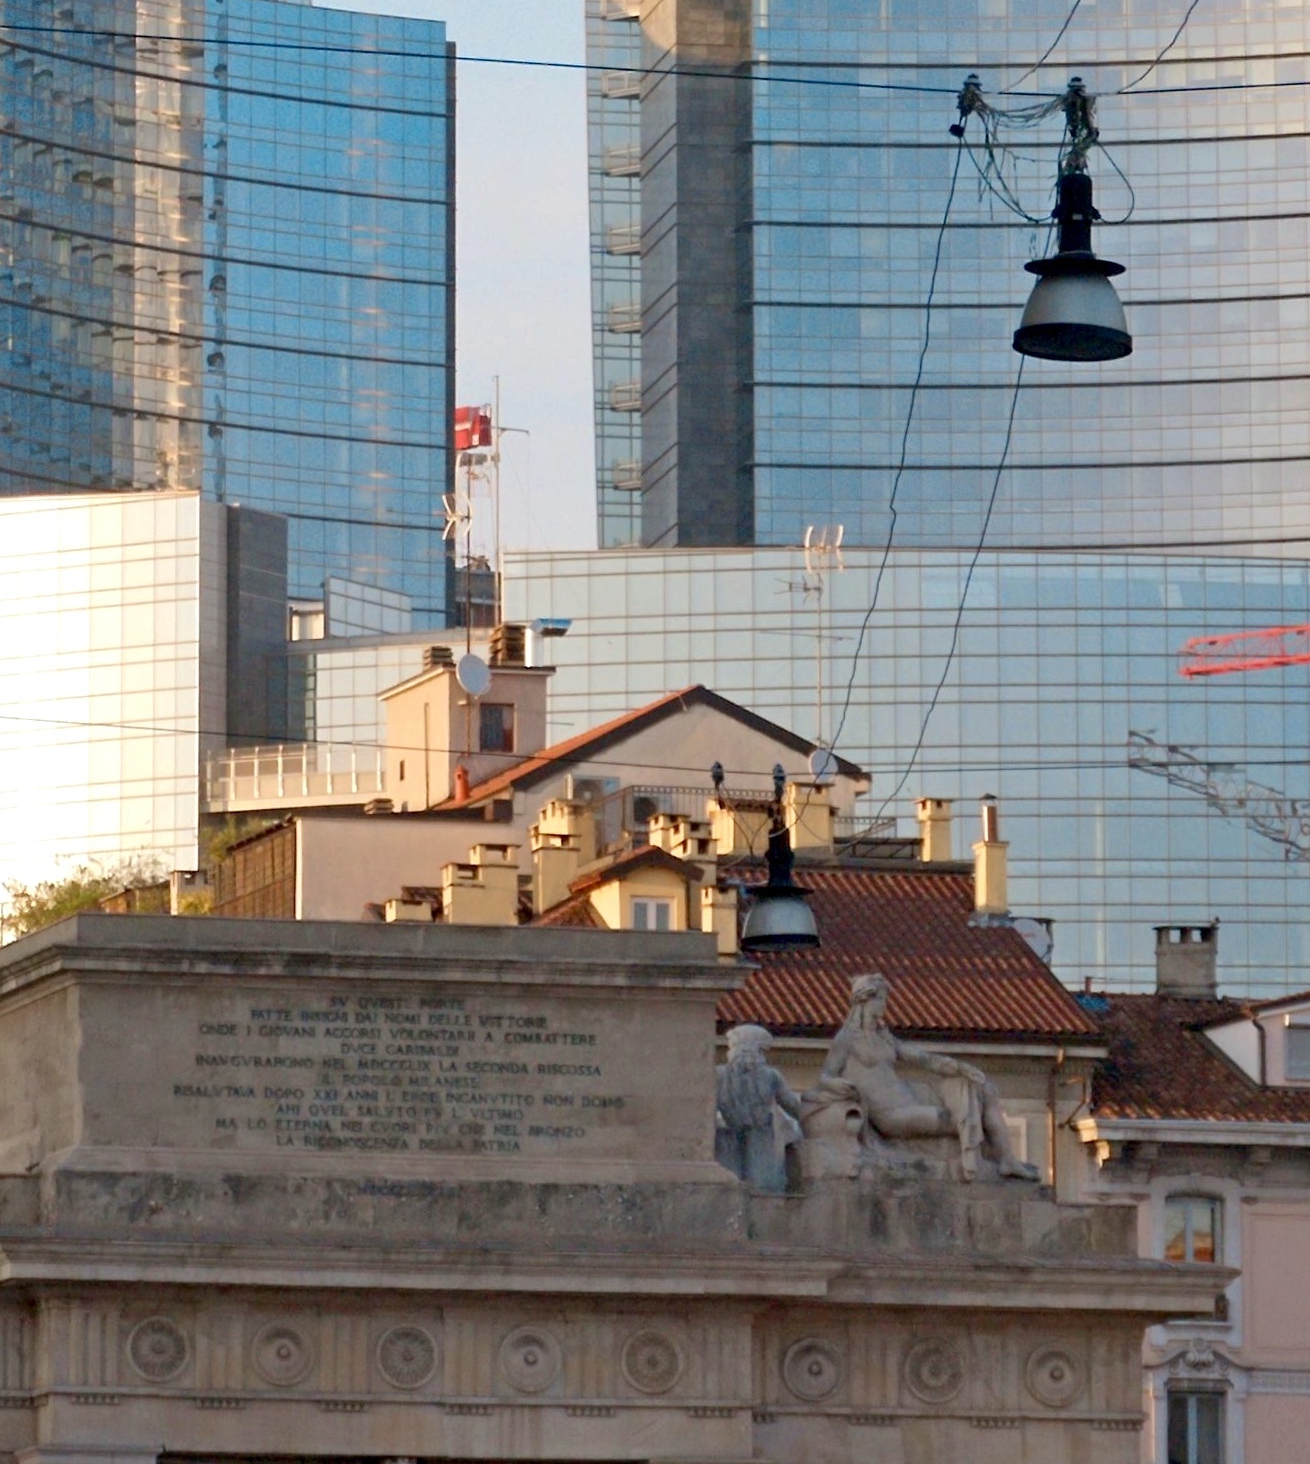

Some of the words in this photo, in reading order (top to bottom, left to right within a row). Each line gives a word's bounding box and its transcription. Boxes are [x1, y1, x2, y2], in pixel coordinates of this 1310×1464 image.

[384, 1013, 421, 1025] NOMI
[427, 1014, 473, 1026] DELLE
[199, 1023, 238, 1036] ONDE
[258, 1025, 316, 1038] GIOVANI
[323, 1027, 381, 1040] ACCORSI
[503, 1032, 597, 1046] COMBATTERE
[341, 1042, 377, 1055] DVCE
[385, 1044, 459, 1057] GARIBALDI
[322, 1057, 347, 1070] NEL
[439, 1060, 458, 1073] LA
[465, 1061, 529, 1075] SECONDA
[537, 1063, 602, 1077] RISCOSSA
[263, 1086, 305, 1100] DOPO
[312, 1088, 338, 1101] XXI
[347, 1089, 379, 1102] ANNI
[542, 1094, 574, 1108] NON
[275, 1103, 301, 1116] AHI
[215, 1117, 238, 1131] MA
[246, 1117, 268, 1131] LO
[274, 1119, 332, 1133] ETERNA
[493, 1124, 521, 1137] NEL
[528, 1125, 586, 1139] BRONZO
[275, 1134, 294, 1147] LA
